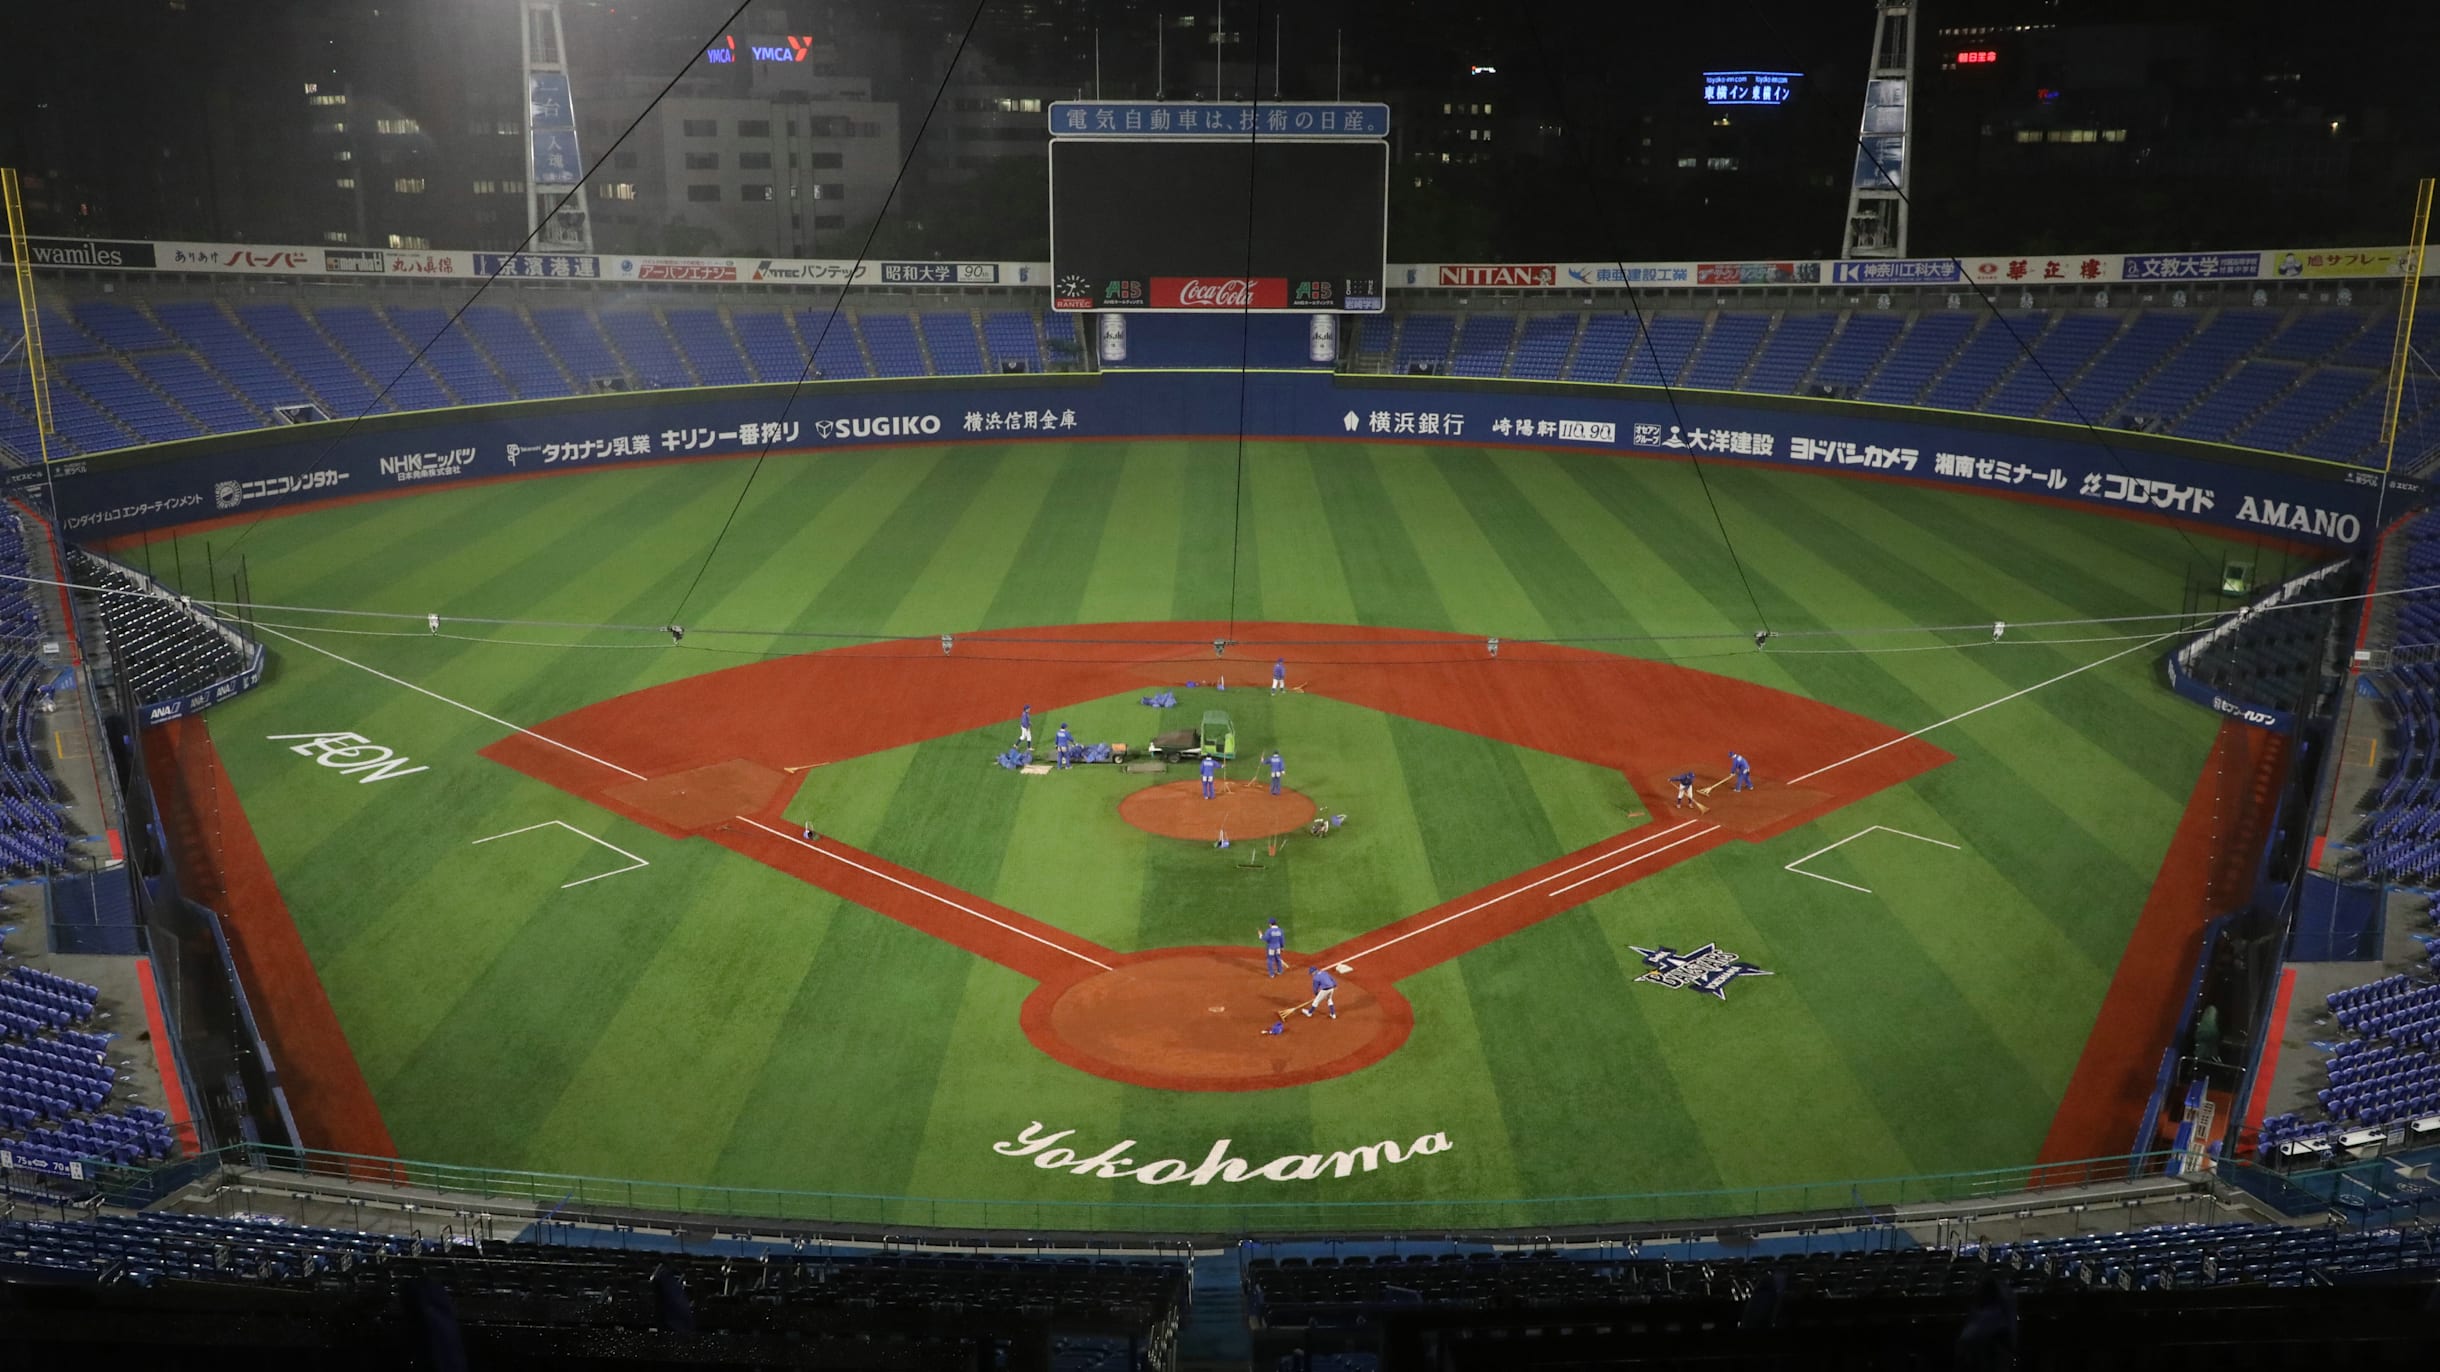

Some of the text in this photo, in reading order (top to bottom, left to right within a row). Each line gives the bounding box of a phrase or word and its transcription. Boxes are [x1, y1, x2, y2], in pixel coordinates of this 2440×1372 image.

[707, 48, 731, 63] YMCA
[752, 46, 793, 61] YMCA
[1704, 85, 1749, 100] 東横イン
[1752, 85, 1790, 100] 東横イン
[1066, 109, 1375, 130] 電気自動車は、技術の日産。
[32, 242, 122, 266] wamiles
[175, 250, 307, 268] ありあけ ハーバー
[801, 265, 867, 278] バンテック
[885, 265, 951, 281] 昭和大学
[1440, 266, 1533, 285] NITTAN
[1596, 268, 1688, 282] 東亜建設工業
[1863, 262, 1954, 278] 神奈川工科大学
[2142, 257, 2219, 279] 文教大学
[835, 415, 941, 438] SUGIKO
[963, 409, 1078, 432] 横浜信用金庫
[1368, 410, 1465, 436] 横浜銀行
[1491, 418, 1558, 438] 崎陽軒
[660, 420, 800, 452] キリン一番搾り
[1687, 427, 1775, 457] 大洋建設
[541, 434, 652, 464] タカナシ乳業
[1790, 436, 1920, 471] ヨドバシカメラ
[1934, 452, 2068, 490] 湘南ゼミナール
[241, 469, 350, 500] ニコニコレンタカー
[2103, 473, 2216, 515] コロワイド
[2235, 495, 2361, 544] AMANO
[150, 705, 171, 719] ANA
[992, 1120, 1454, 1186] Yokohama
